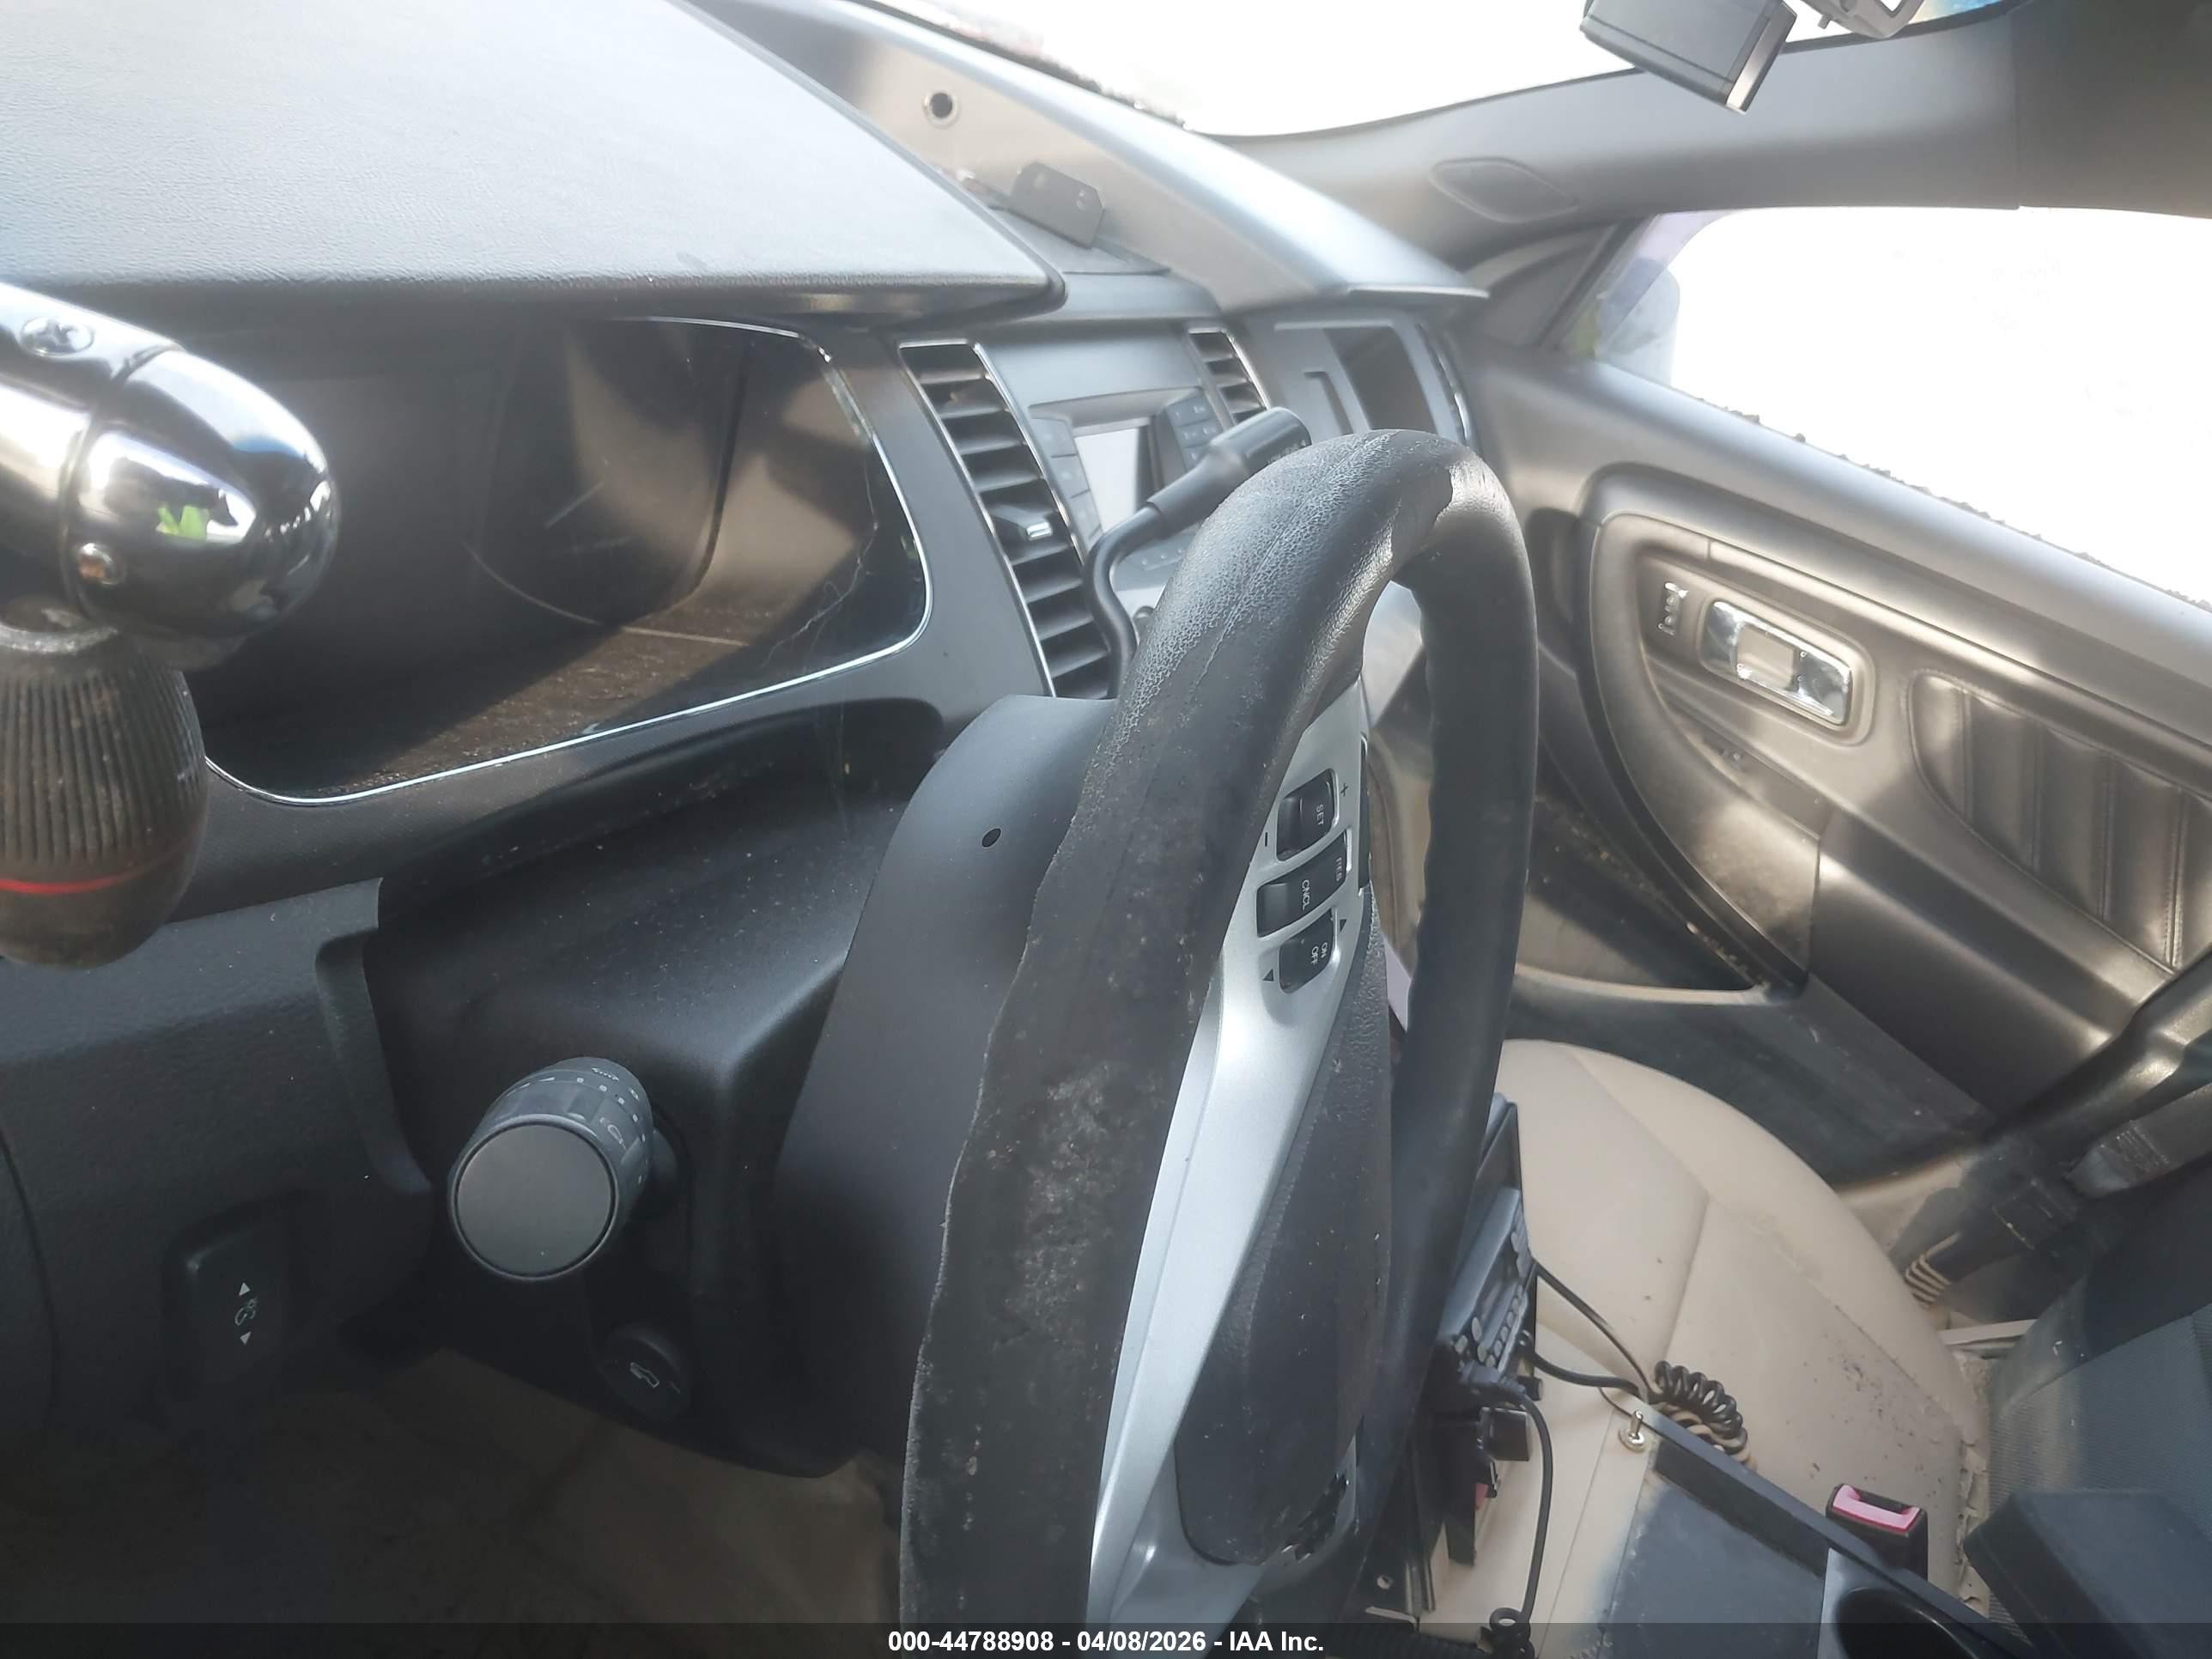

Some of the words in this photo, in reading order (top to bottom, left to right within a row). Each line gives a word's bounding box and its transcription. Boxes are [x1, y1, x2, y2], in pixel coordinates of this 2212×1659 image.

[1316, 804, 1325, 826] SET
[1301, 878, 1310, 912] CNCL
[1320, 941, 1328, 958] ON
